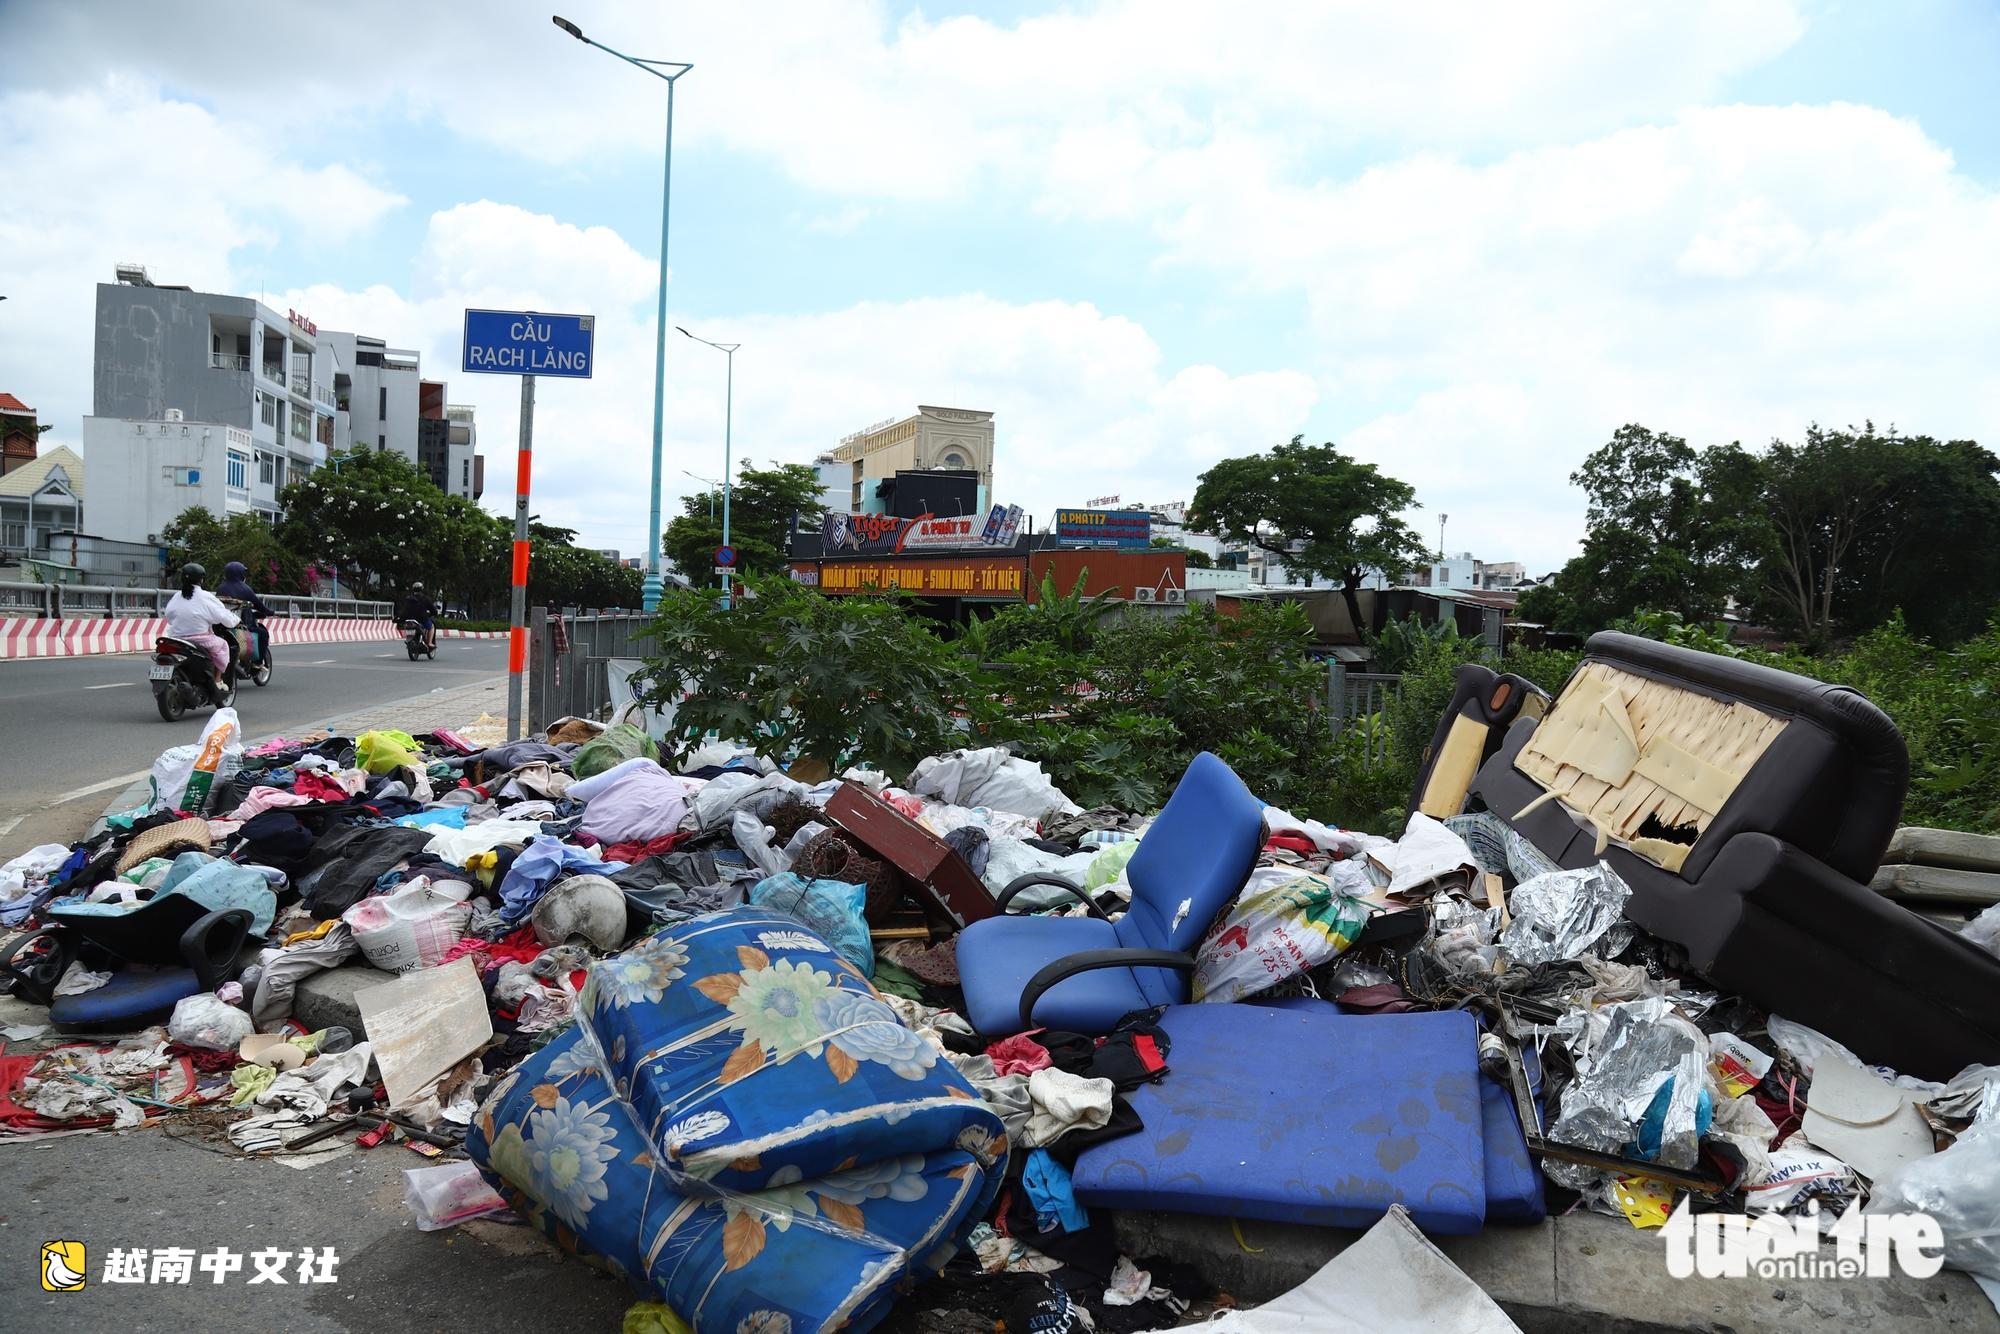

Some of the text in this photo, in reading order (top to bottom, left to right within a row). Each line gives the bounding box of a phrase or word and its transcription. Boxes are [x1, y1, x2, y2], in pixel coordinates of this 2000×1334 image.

[510, 315, 551, 342] CẦU
[469, 346, 587, 371] RẠCH LĂNG
[852, 511, 900, 541] Tiger
[822, 564, 845, 592] NHẬN
[900, 568, 923, 589] HOAN
[929, 569, 951, 590] SINH
[951, 565, 975, 594] NHẬT
[981, 563, 997, 591] TẤT
[998, 565, 1021, 591] NIÊN
[1262, 955, 1280, 973] 25
[1806, 1161, 1824, 1170] XI
